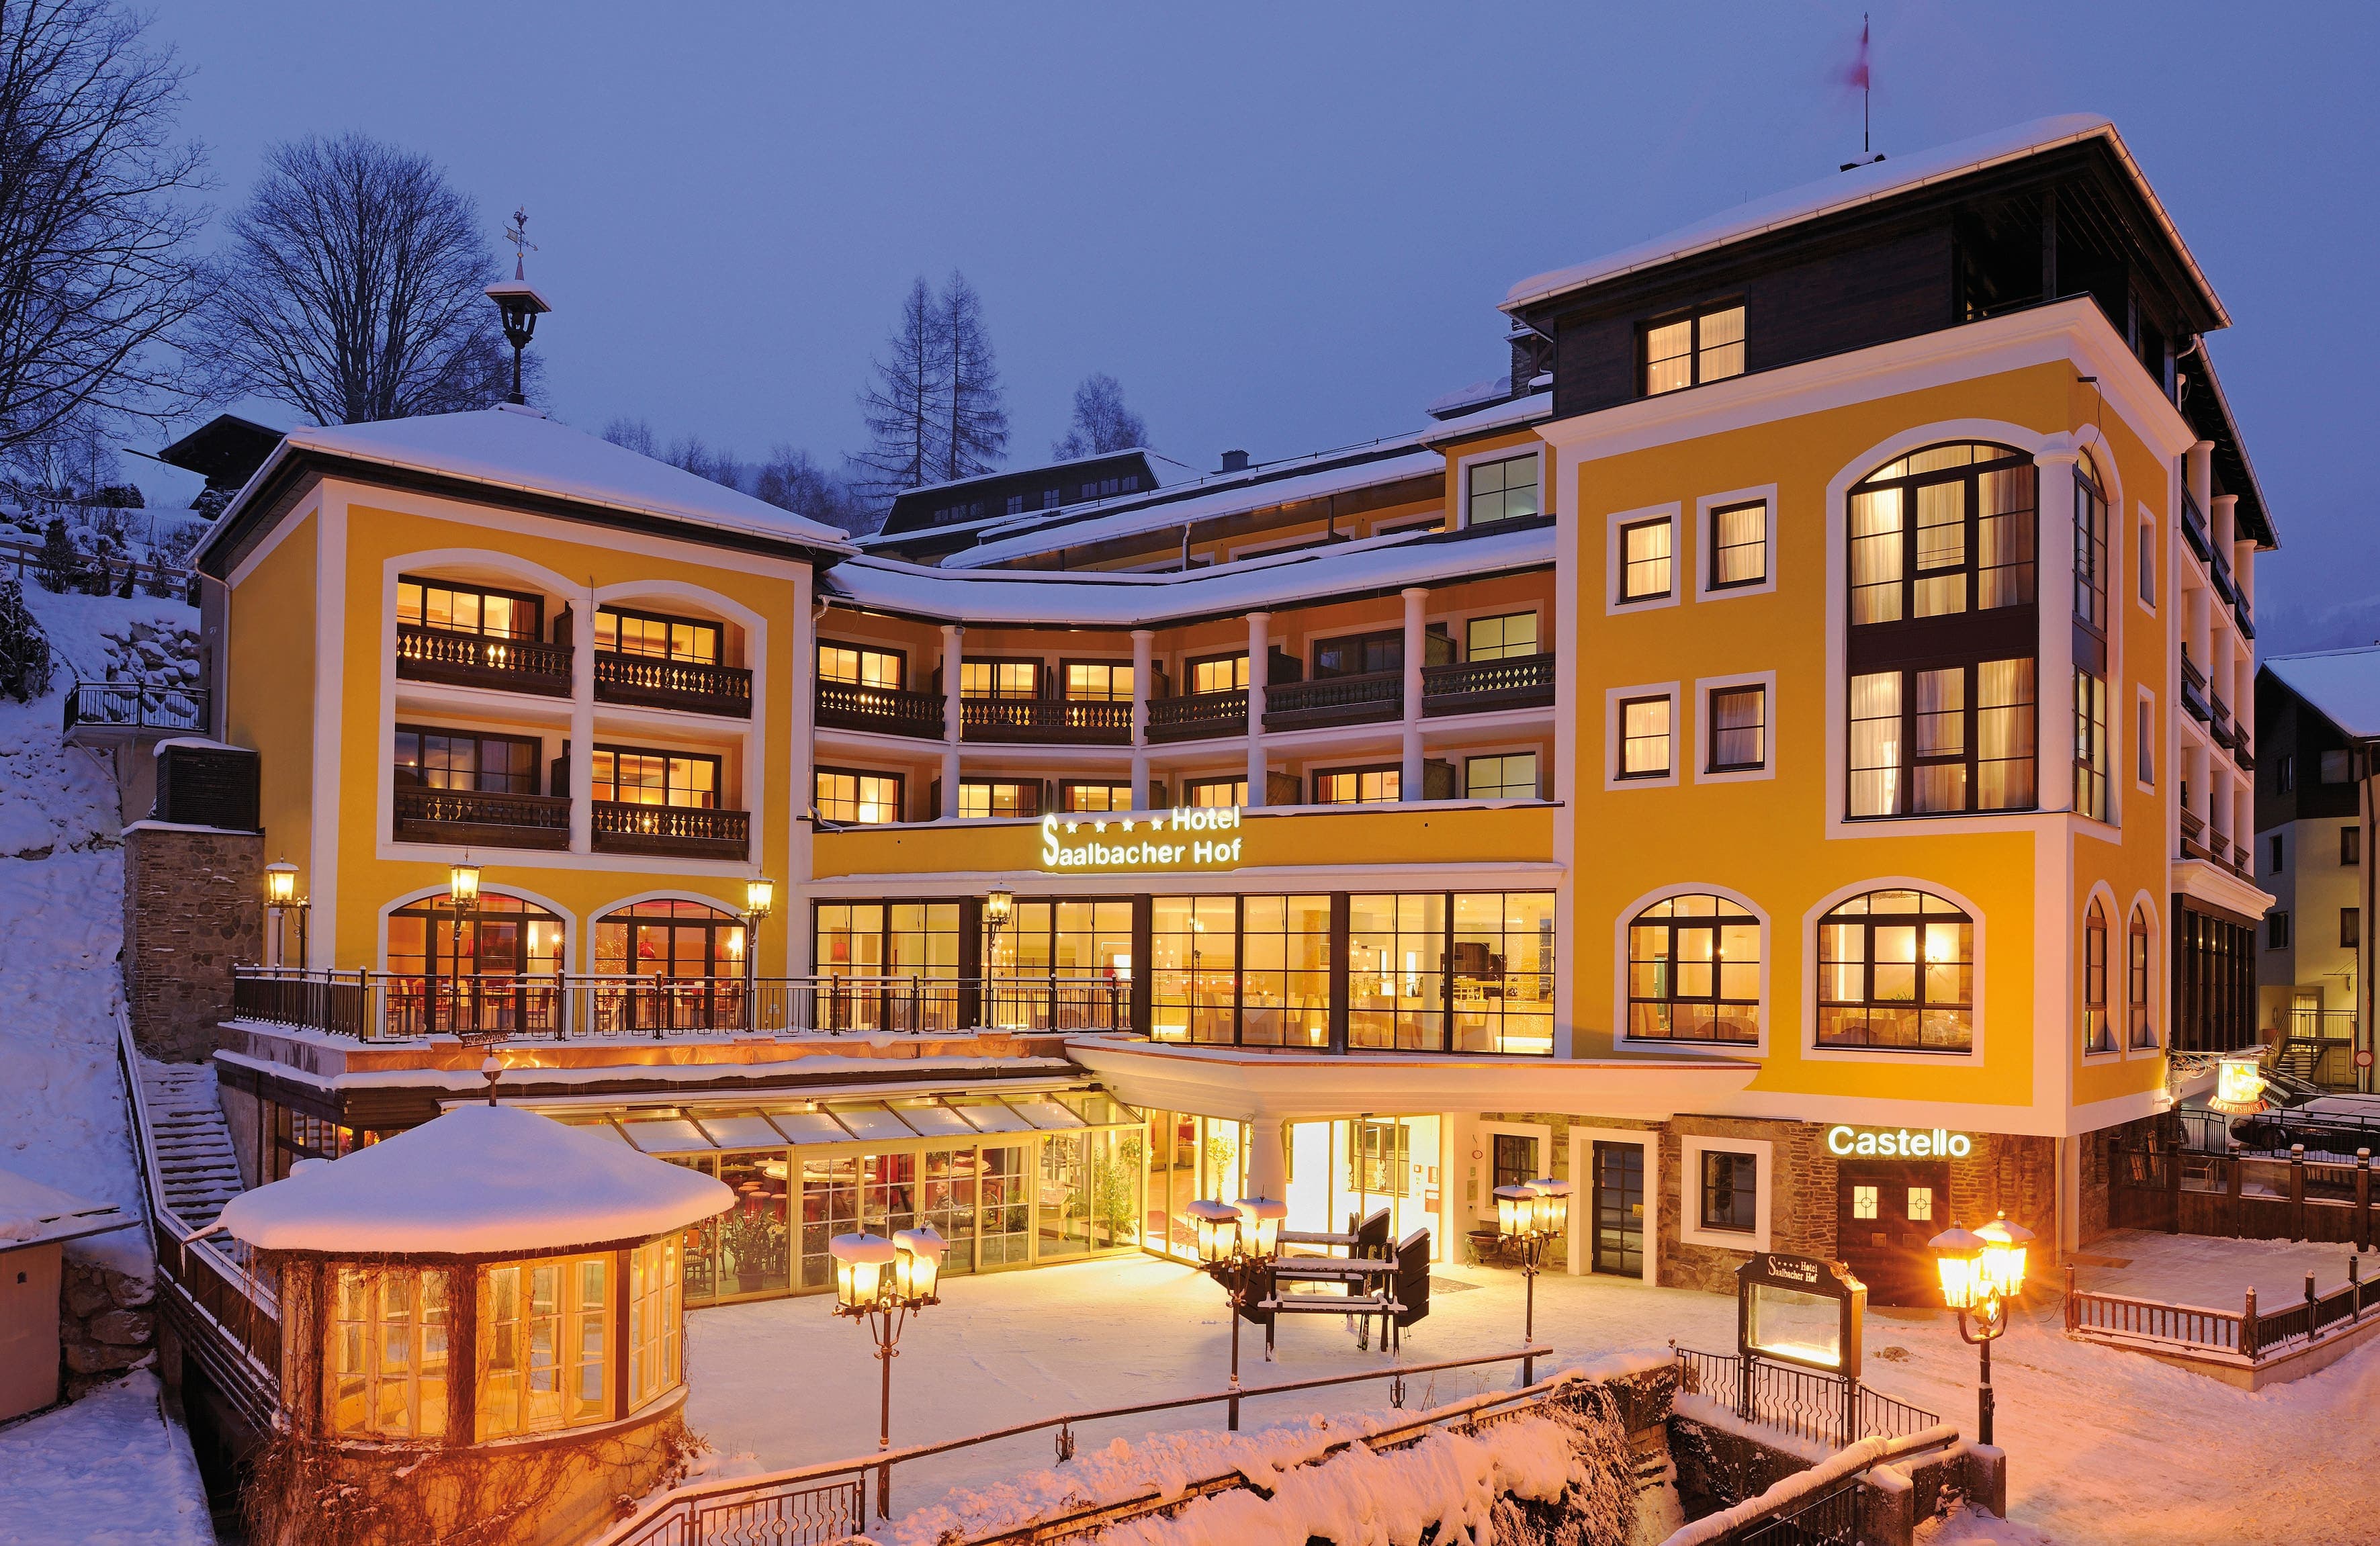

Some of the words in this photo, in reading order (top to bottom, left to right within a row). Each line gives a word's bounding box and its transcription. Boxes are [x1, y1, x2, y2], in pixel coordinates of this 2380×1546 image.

[1172, 805, 1241, 831] Hotel
[1042, 813, 1186, 866] Saalbacher
[1194, 838, 1242, 864] Hof
[1828, 1126, 1971, 1156] Castello
[1768, 1256, 1804, 1281] Saalbacher
[1805, 1272, 1818, 1283] Hof
[1800, 1261, 1818, 1273] Hotel
